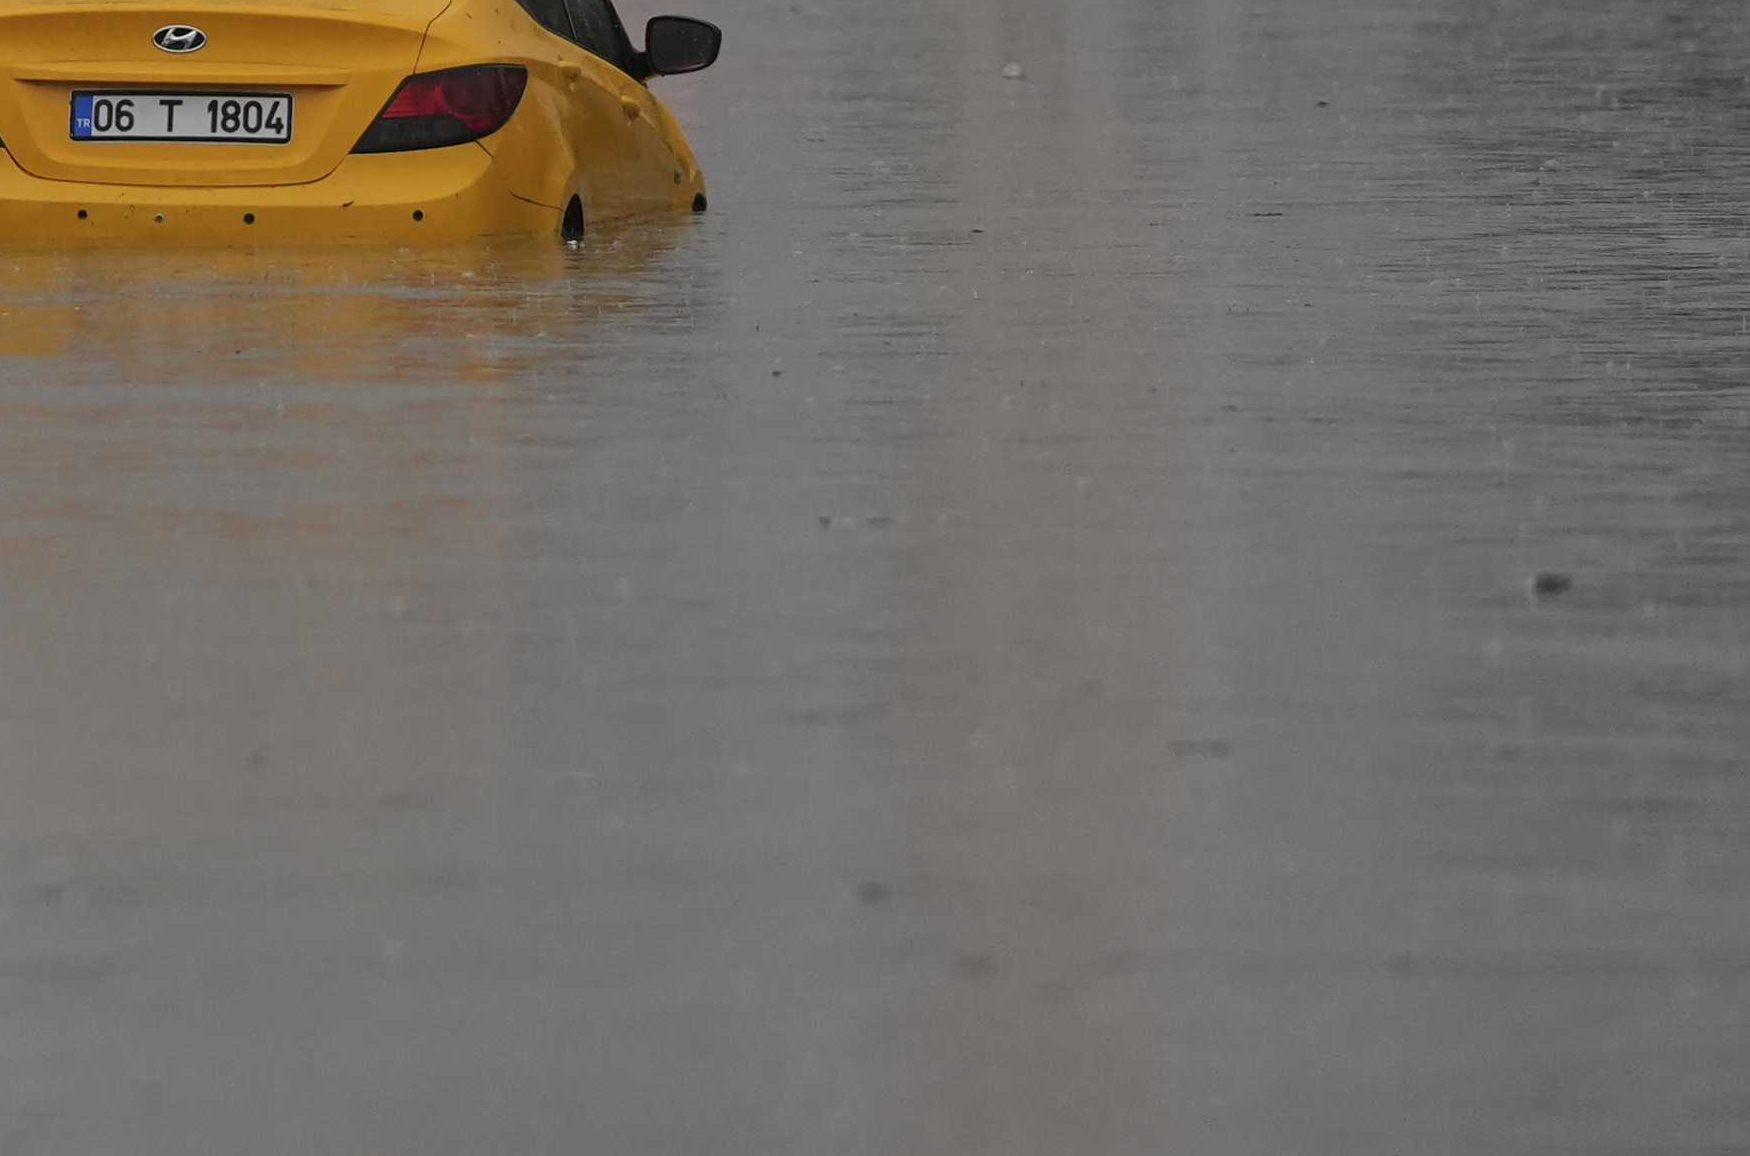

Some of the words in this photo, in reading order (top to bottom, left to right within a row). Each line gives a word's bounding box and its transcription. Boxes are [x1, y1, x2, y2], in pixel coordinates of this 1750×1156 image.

[76, 117, 91, 129] TR
[93, 98, 135, 133] 06
[158, 99, 184, 133] T
[206, 99, 285, 135] 1804
